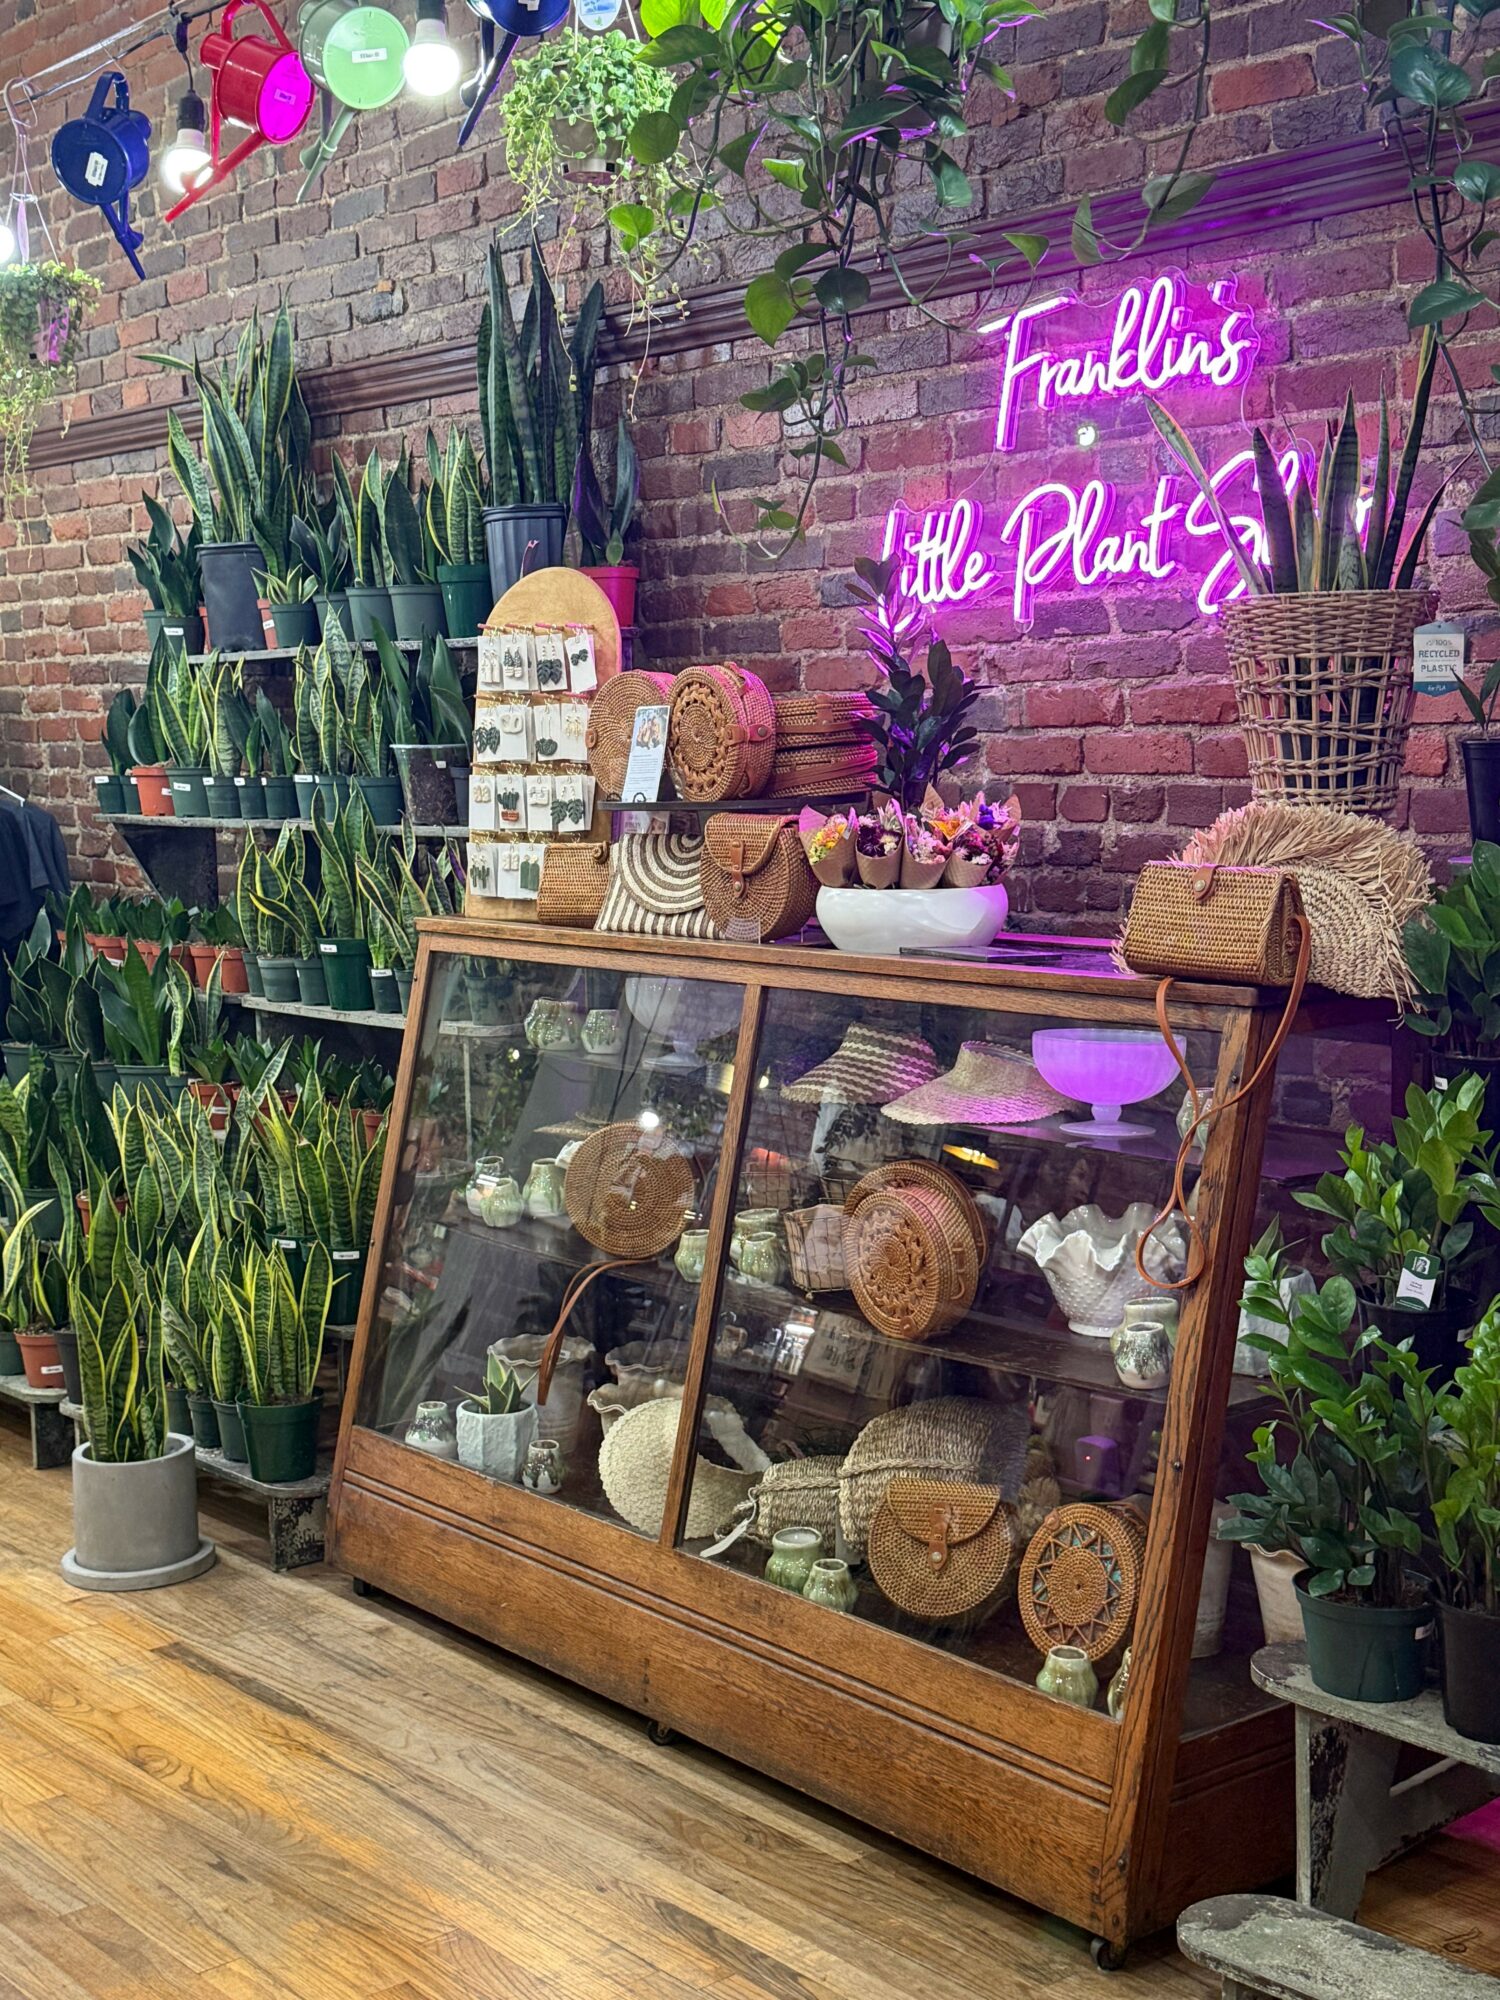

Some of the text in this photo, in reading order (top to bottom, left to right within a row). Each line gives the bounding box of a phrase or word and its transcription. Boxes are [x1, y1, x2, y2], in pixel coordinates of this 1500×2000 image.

[977, 278, 1255, 450] Franklin's
[882, 498, 994, 633] Little
[1001, 479, 1182, 632] Plant
[1418, 650, 1460, 658] RECYCLED
